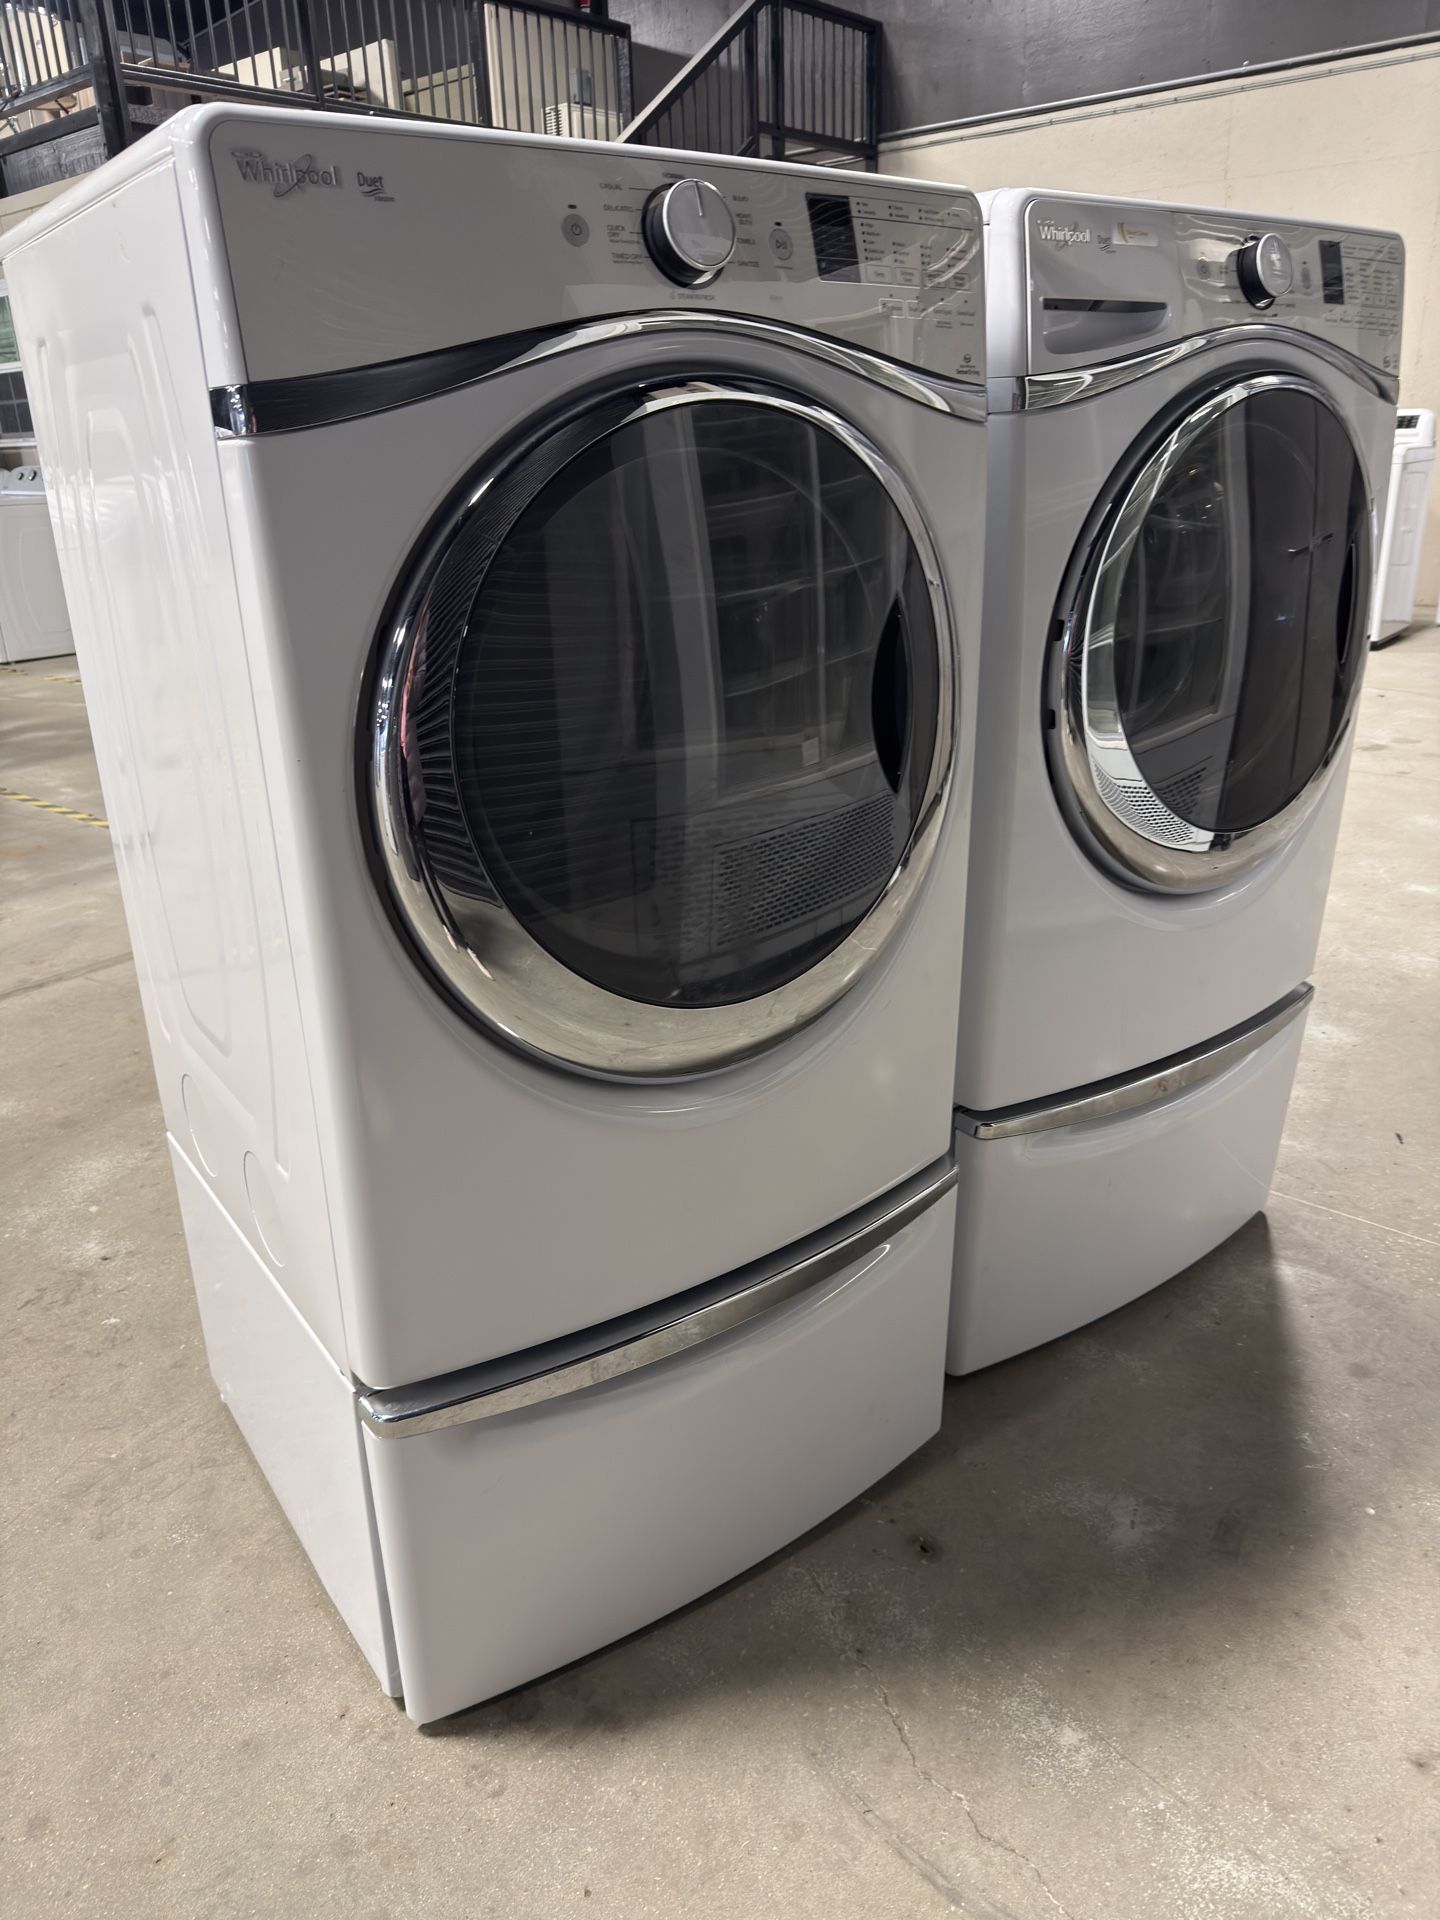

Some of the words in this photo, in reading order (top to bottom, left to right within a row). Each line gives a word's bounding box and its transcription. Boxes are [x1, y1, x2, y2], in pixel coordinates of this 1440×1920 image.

[233, 153, 339, 195] Whirlpool
[357, 171, 385, 188] Duet
[1038, 223, 1091, 247] Whirlpool
